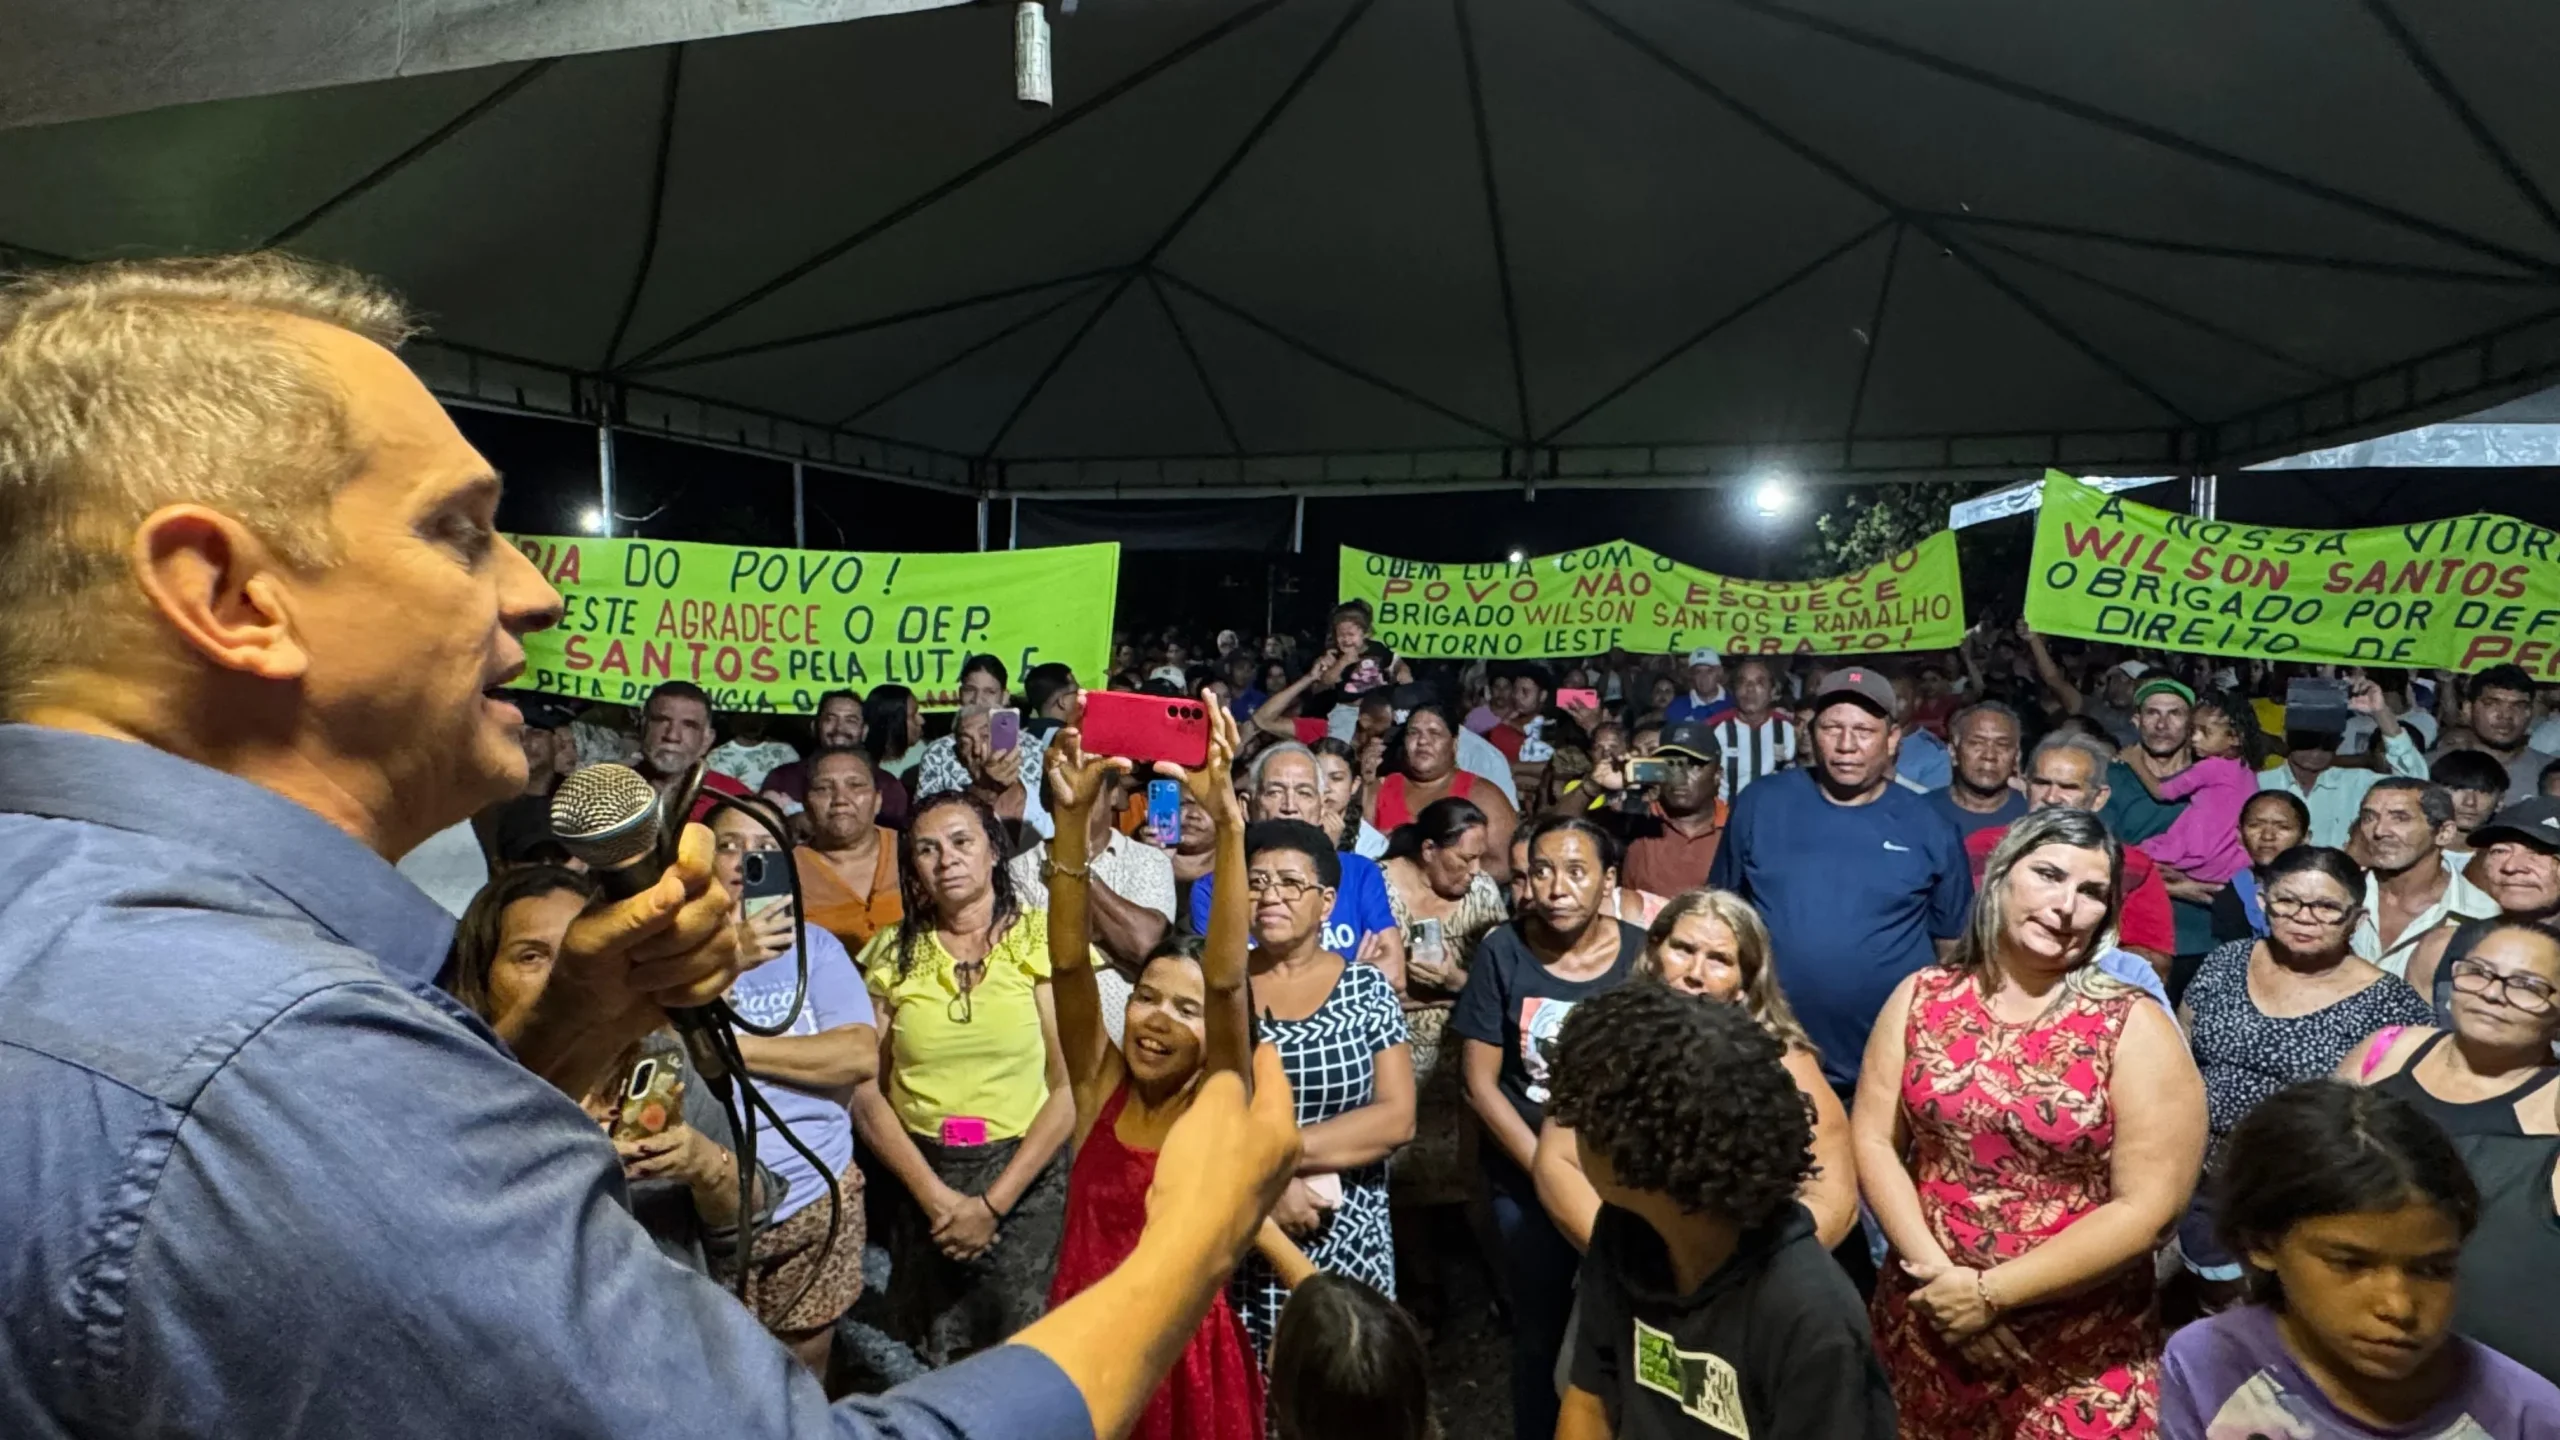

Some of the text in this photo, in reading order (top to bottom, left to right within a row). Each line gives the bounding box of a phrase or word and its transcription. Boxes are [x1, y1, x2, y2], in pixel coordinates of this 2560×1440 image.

[2096, 496, 2560, 563] A NOSSA VITOR
[625, 544, 680, 589] DO
[731, 551, 862, 594] POVO
[1366, 555, 1441, 580] QUEM
[1463, 563, 1534, 580] LUTA
[1559, 545, 1632, 573] COM
[2064, 521, 2530, 599] WILSON SANTOS
[1379, 593, 1951, 635] BRIGADO WILSON SANTOS E RAMALHO
[1383, 568, 1902, 612] POVO NÃO ESQUECE
[2046, 561, 2560, 636] OBRIGADO POR DEF
[557, 595, 991, 645] ESTE AGRADECE O DEP.
[1383, 631, 1523, 655] ONTORNO
[1544, 628, 1624, 653] LESTE
[2095, 605, 2300, 653] DIREITO
[2343, 638, 2416, 661] DE
[564, 634, 780, 683] SANTOS
[790, 650, 868, 684] PELA
